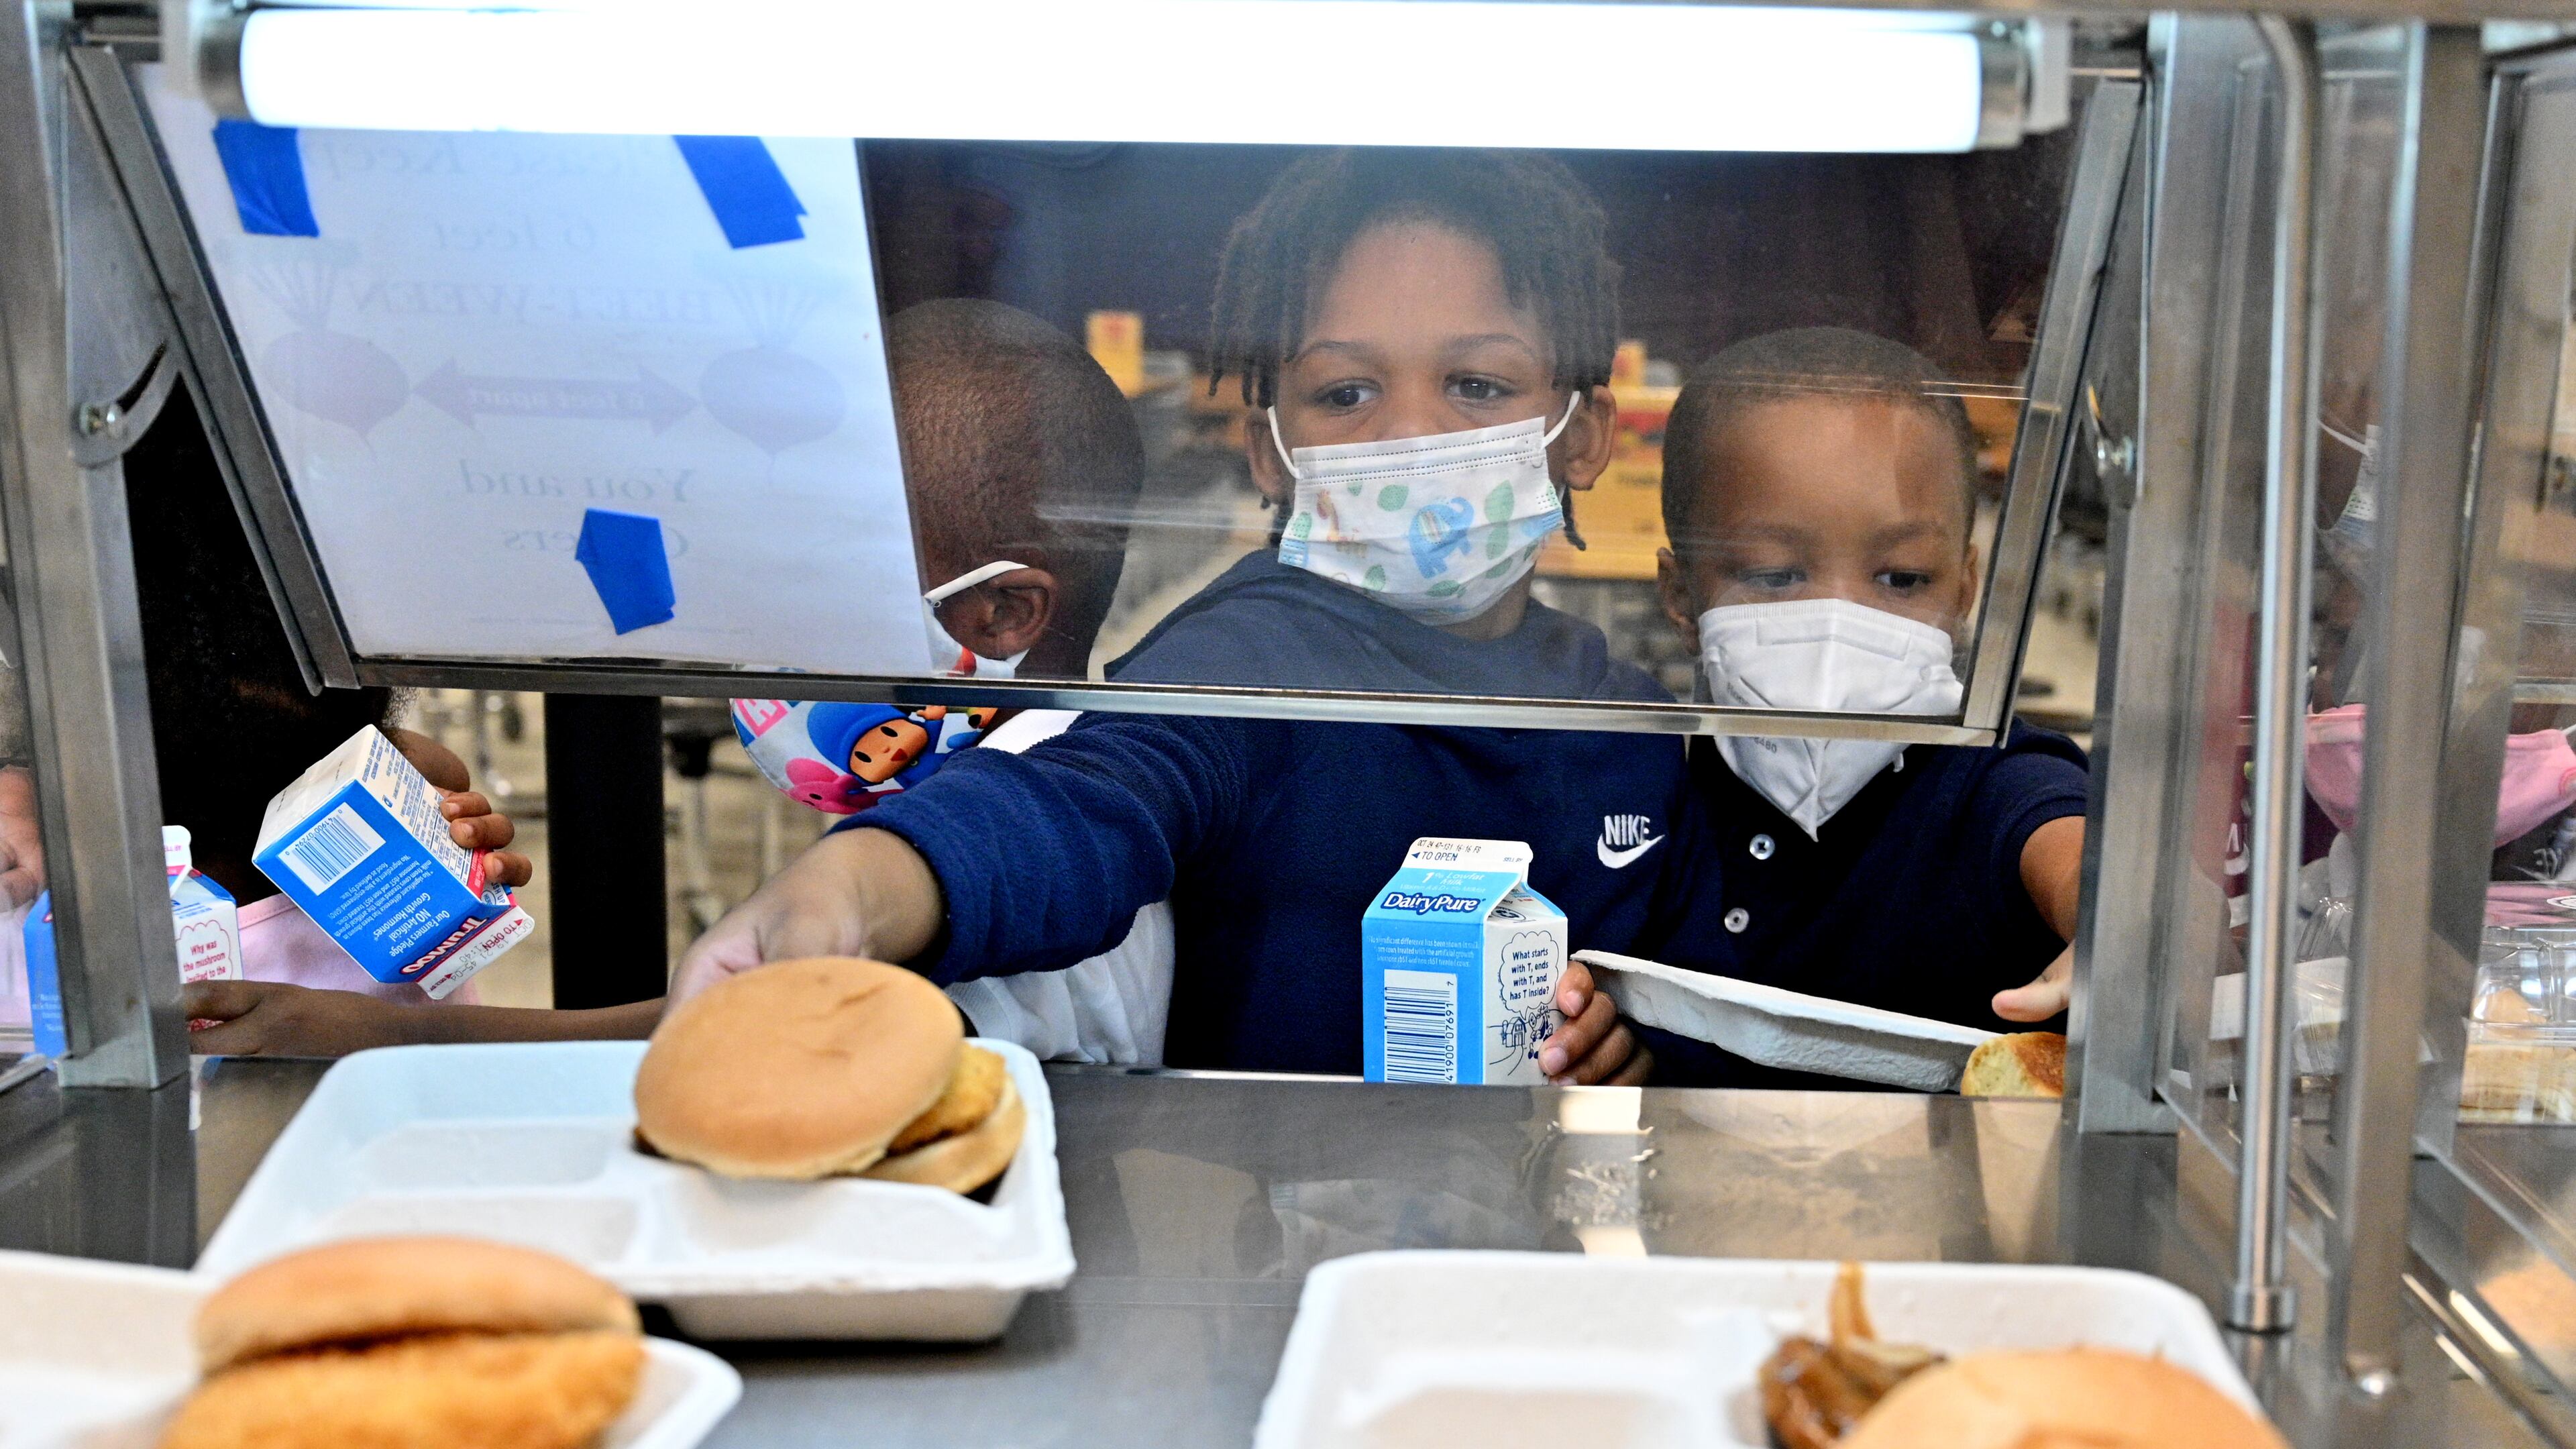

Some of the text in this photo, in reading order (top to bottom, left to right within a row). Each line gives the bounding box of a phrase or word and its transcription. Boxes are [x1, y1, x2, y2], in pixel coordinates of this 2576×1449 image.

[1604, 814, 1650, 845] NIKE
[1421, 851, 1458, 861] TO OPEN
[375, 861, 389, 873] food
[376, 858, 404, 880] ingredient
[397, 860, 420, 879] hormone
[419, 859, 433, 871] milk
[388, 875, 401, 886] rbST
[398, 875, 412, 886] cows
[409, 867, 423, 879] from
[354, 873, 374, 890] defined
[379, 883, 392, 893] and
[398, 874, 425, 896] significant
[372, 890, 382, 899] non
[383, 884, 402, 900] treated
[373, 896, 387, 907] with
[378, 893, 403, 912] difference
[402, 891, 432, 915] Growth
[1383, 893, 1479, 913] DairyPure
[346, 904, 366, 919] treated
[348, 910, 370, 927] artificial
[370, 909, 382, 918] has
[360, 915, 374, 927] been
[387, 908, 431, 943] NO Artificial
[332, 922, 352, 938] growth
[386, 909, 451, 959] Our Farmers Pledge
[481, 922, 516, 952] TO OPEN
[191, 941, 217, 955] Why was
[400, 917, 489, 975] TruMoo
[1513, 947, 1548, 961] What starts
[183, 952, 225, 972] the mushroom
[1511, 960, 1548, 973] with T, ends
[209, 969, 215, 977] to
[216, 966, 226, 975] the
[1513, 973, 1547, 987] with T, and
[1509, 991, 1521, 1000] has
[1529, 986, 1550, 998] inside?
[1446, 1002, 1454, 1039] 07691
[1446, 1045, 1454, 1081] 41900
